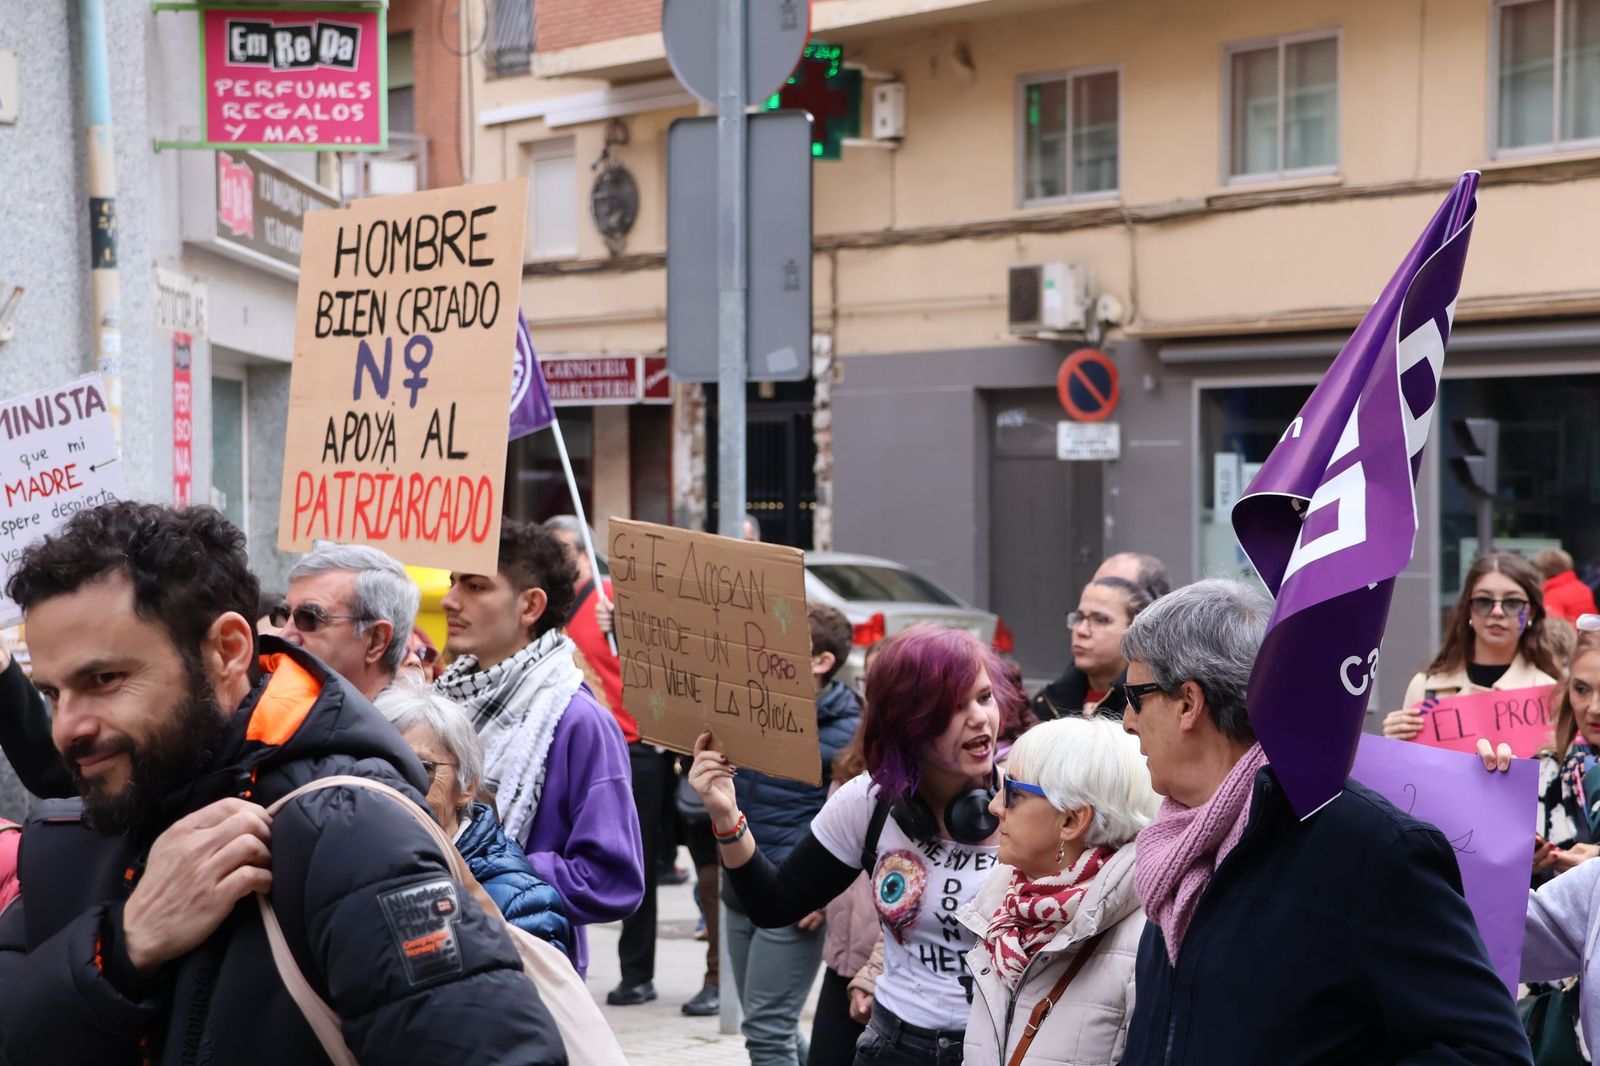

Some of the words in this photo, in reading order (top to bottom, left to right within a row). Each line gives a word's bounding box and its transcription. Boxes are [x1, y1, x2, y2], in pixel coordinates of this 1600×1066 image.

[214, 79, 372, 100] PERFUMES
[222, 102, 365, 121] REGALOS
[224, 124, 247, 141] Y
[263, 125, 319, 143] MAS
[334, 206, 497, 278] HOMBRE
[315, 288, 388, 339] BIEN
[396, 281, 500, 335] CRIADO
[549, 380, 637, 400] HARCUTERIA
[321, 409, 397, 464] APOYA
[421, 402, 469, 460] AL
[20, 448, 49, 471] que
[67, 436, 86, 453] mi
[5, 463, 84, 508] MADRE
[51, 487, 118, 519] despierta
[292, 471, 494, 543] PATRIARCADO
[703, 628, 730, 668] UN
[1431, 707, 1476, 742] EL
[974, 852, 1000, 871] EY
[933, 877, 962, 943] DOWN
